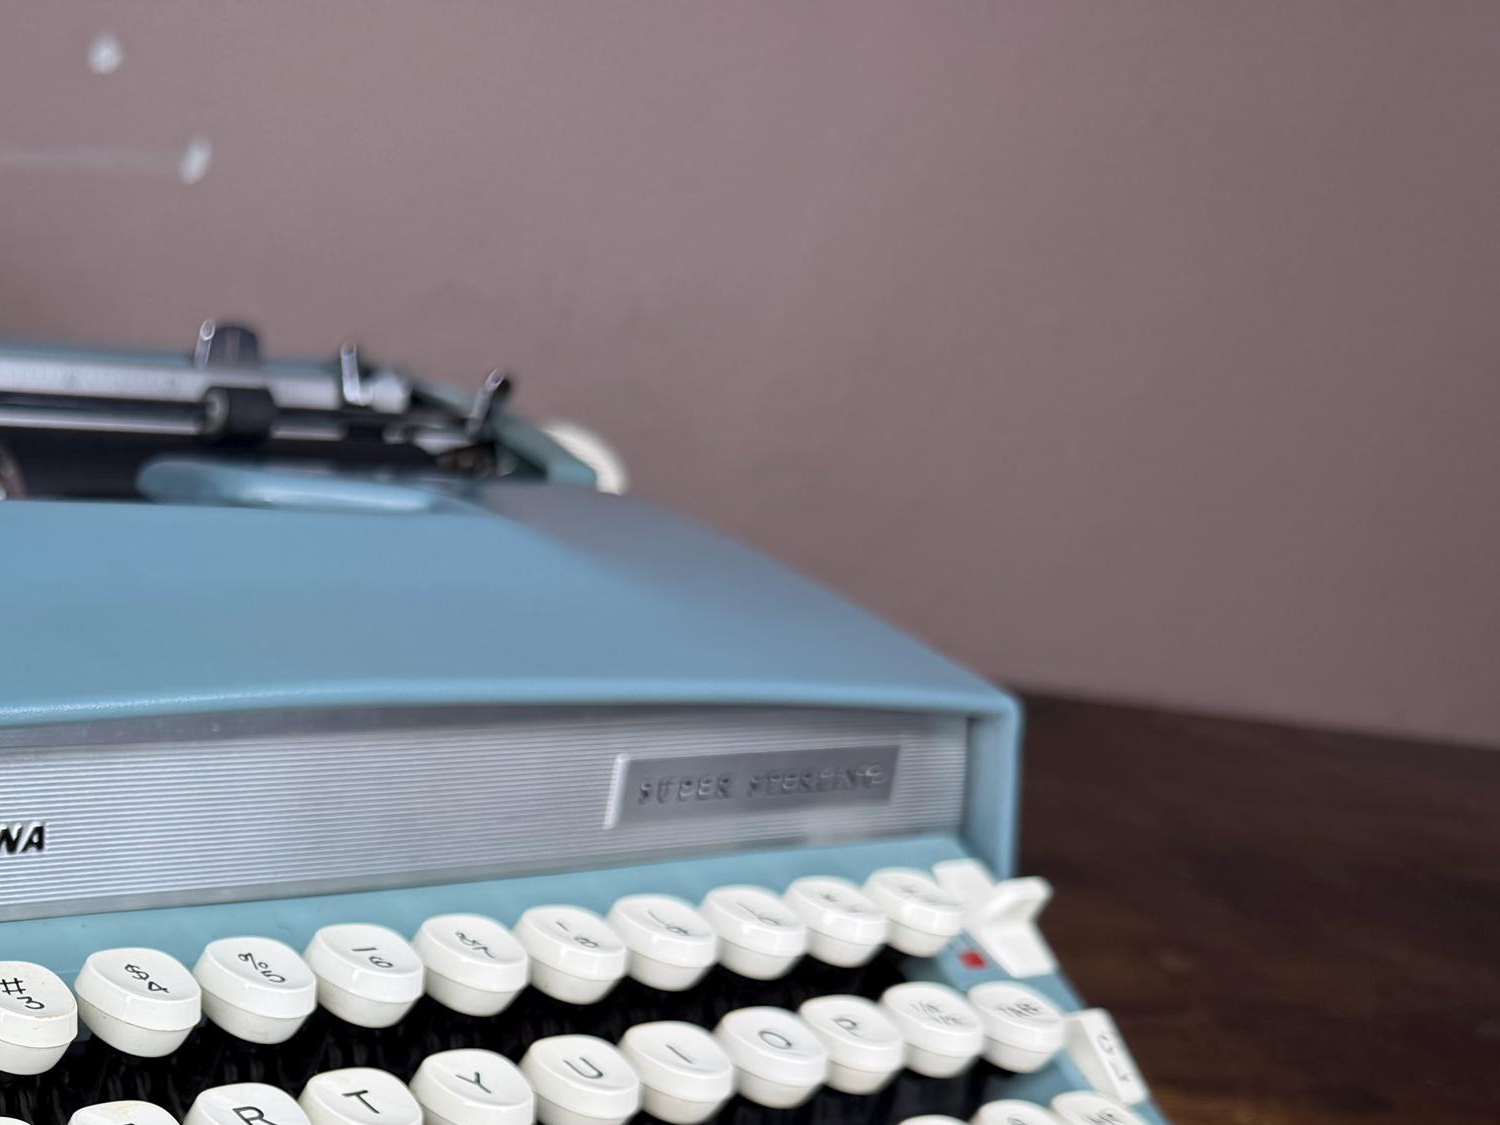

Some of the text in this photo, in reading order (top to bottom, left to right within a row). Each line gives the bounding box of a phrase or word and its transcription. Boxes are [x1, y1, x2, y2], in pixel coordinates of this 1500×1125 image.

[664, 924, 692, 936] 9
[574, 936, 600, 948] 8
[238, 953, 267, 974] %
[369, 956, 393, 968] 6
[125, 964, 149, 981] $
[260, 972, 286, 983] 5
[0, 978, 26, 995] #
[148, 981, 169, 993] 4
[17, 996, 45, 1009] 3
[833, 1016, 859, 1037] P
[758, 1030, 794, 1050] O
[563, 1057, 604, 1079] U
[456, 1072, 491, 1093] Y
[343, 1090, 380, 1114] T
